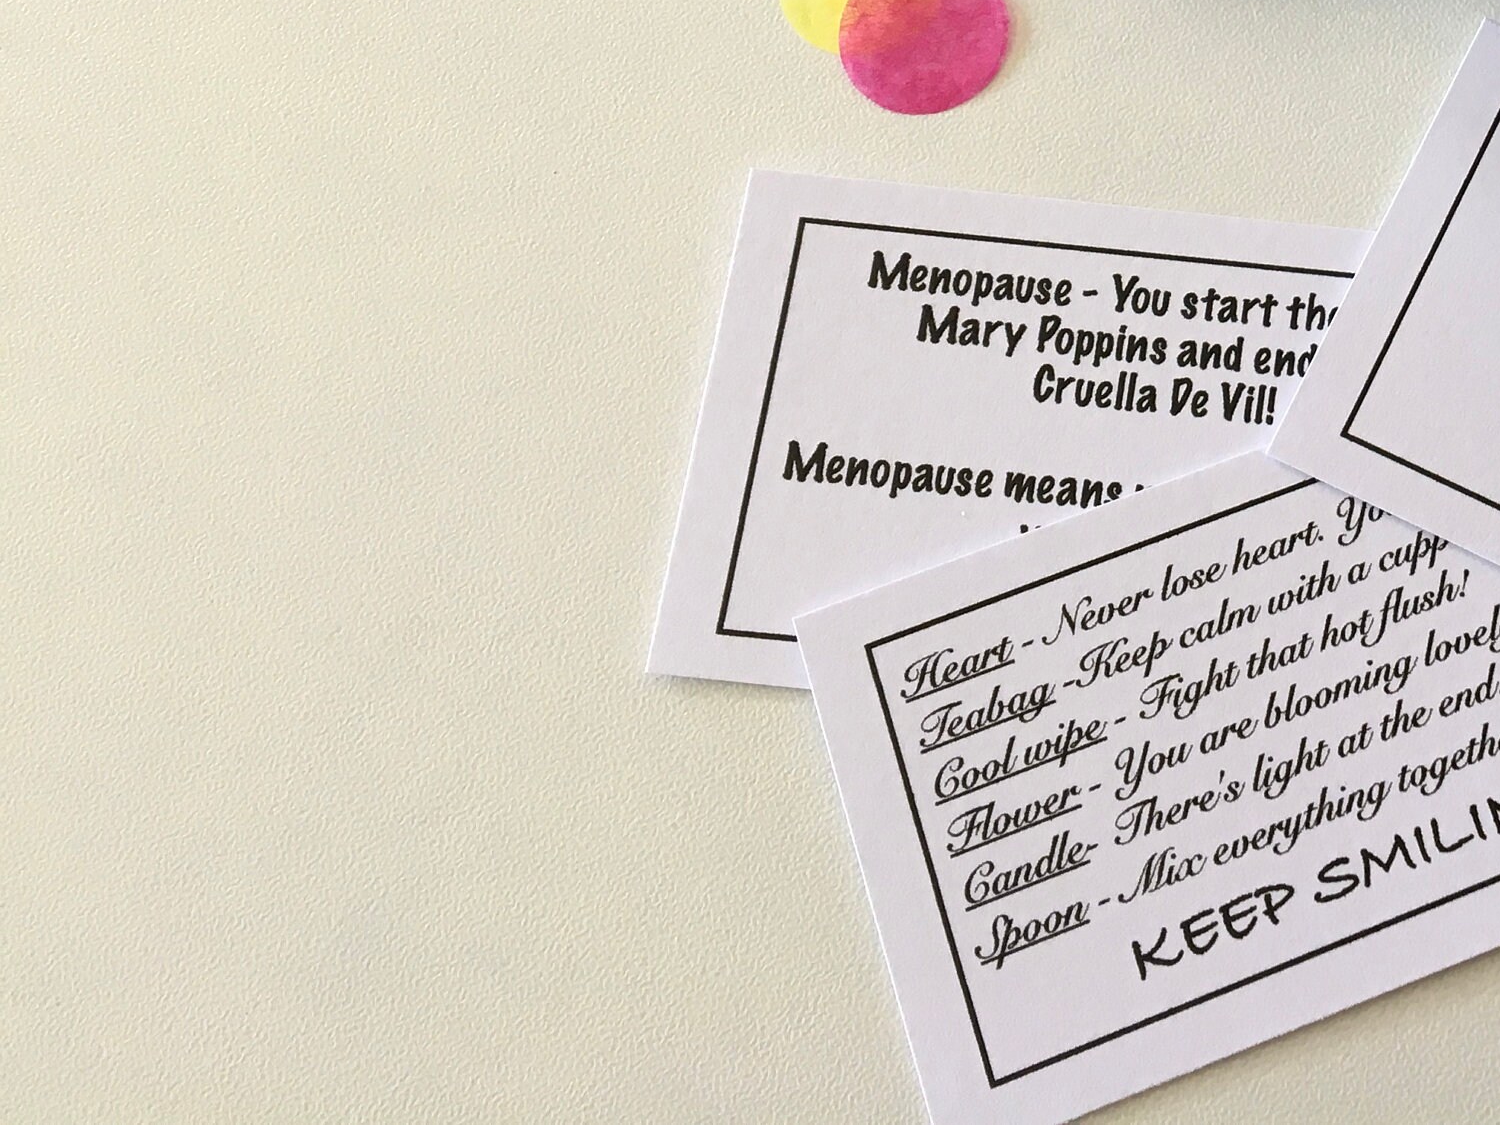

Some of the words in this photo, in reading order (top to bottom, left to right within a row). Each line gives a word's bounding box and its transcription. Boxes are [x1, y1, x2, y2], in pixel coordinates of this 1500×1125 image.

[867, 250, 1073, 307] Menopause
[1112, 273, 1172, 317] You
[1180, 287, 1279, 328] start
[916, 303, 1028, 358] Mary
[1036, 314, 1168, 368] Poppins
[1176, 336, 1245, 373] and
[1032, 363, 1157, 414] Cruella
[1169, 377, 1209, 418] De
[1220, 381, 1278, 426] Vil!
[782, 439, 994, 499] Menopause
[1004, 471, 1123, 509] means
[900, 636, 1016, 704] Heart
[1041, 588, 1154, 646] Never
[1161, 562, 1228, 602] lose
[1231, 521, 1324, 575] heart.
[1336, 496, 1392, 547] Yo
[919, 683, 1057, 755] Teabag
[1179, 597, 1262, 649] calm
[1267, 559, 1342, 615] with
[1347, 561, 1372, 585] a
[934, 736, 1016, 804] Cool
[1023, 718, 1107, 767] wipe
[1139, 657, 1241, 720] Fight
[1246, 632, 1315, 680] that
[1320, 612, 1374, 648] hot
[1366, 569, 1470, 647] flush!
[946, 785, 1083, 859] Flower
[1114, 740, 1193, 801] You
[1199, 717, 1259, 755] are
[1263, 655, 1419, 729] blooming
[1114, 769, 1246, 846] There's
[1252, 736, 1331, 800] light
[1337, 722, 1374, 759] at
[1379, 698, 1433, 742] the
[974, 901, 1091, 970] Spoon
[1117, 846, 1208, 904] Mix
[1213, 780, 1393, 866] everything
[1131, 883, 1295, 981] KEEP
